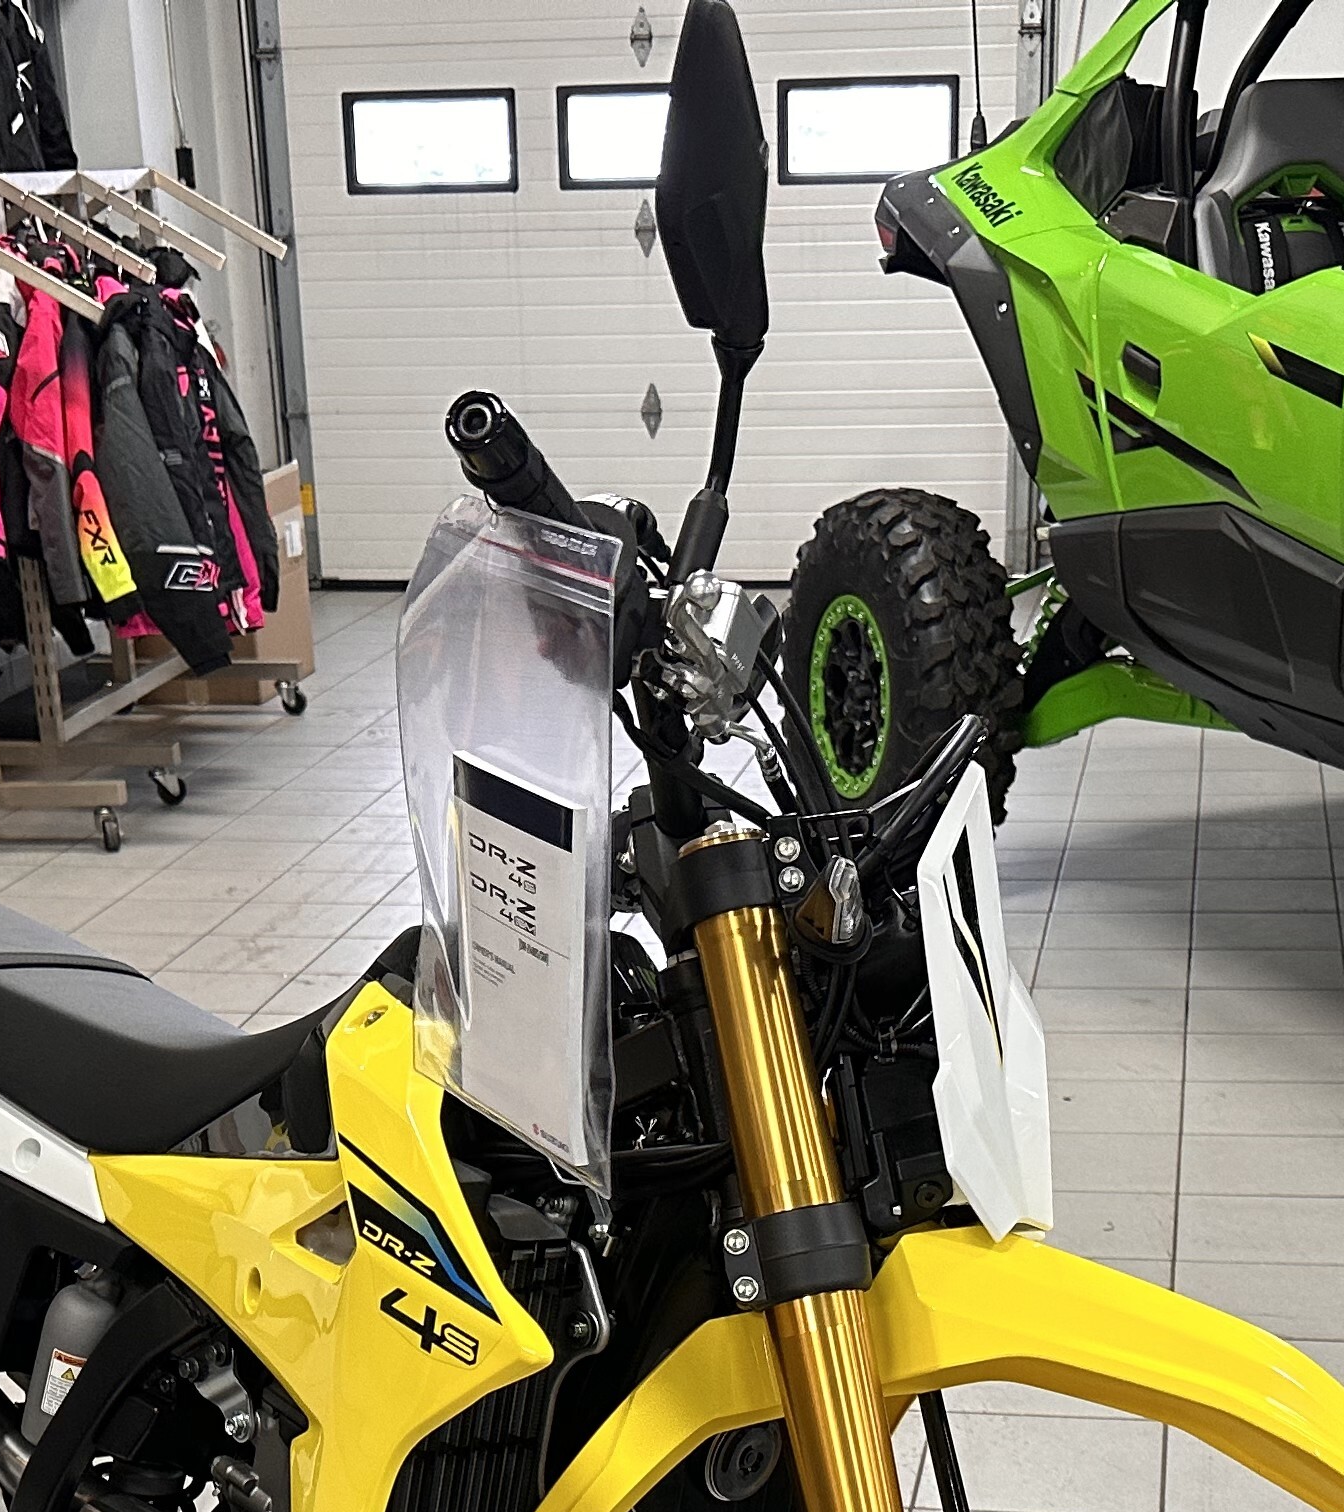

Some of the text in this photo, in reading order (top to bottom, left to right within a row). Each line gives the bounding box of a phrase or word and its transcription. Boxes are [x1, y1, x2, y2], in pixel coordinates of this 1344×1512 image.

[951, 162, 1024, 228] Kawasaki
[1254, 221, 1276, 293] Kawasa
[83, 509, 118, 566] FXR
[468, 831, 537, 880] DR-Z
[469, 871, 537, 921] DR-Z
[361, 1219, 437, 1276] DR-Z
[379, 1287, 480, 1366] 4S
